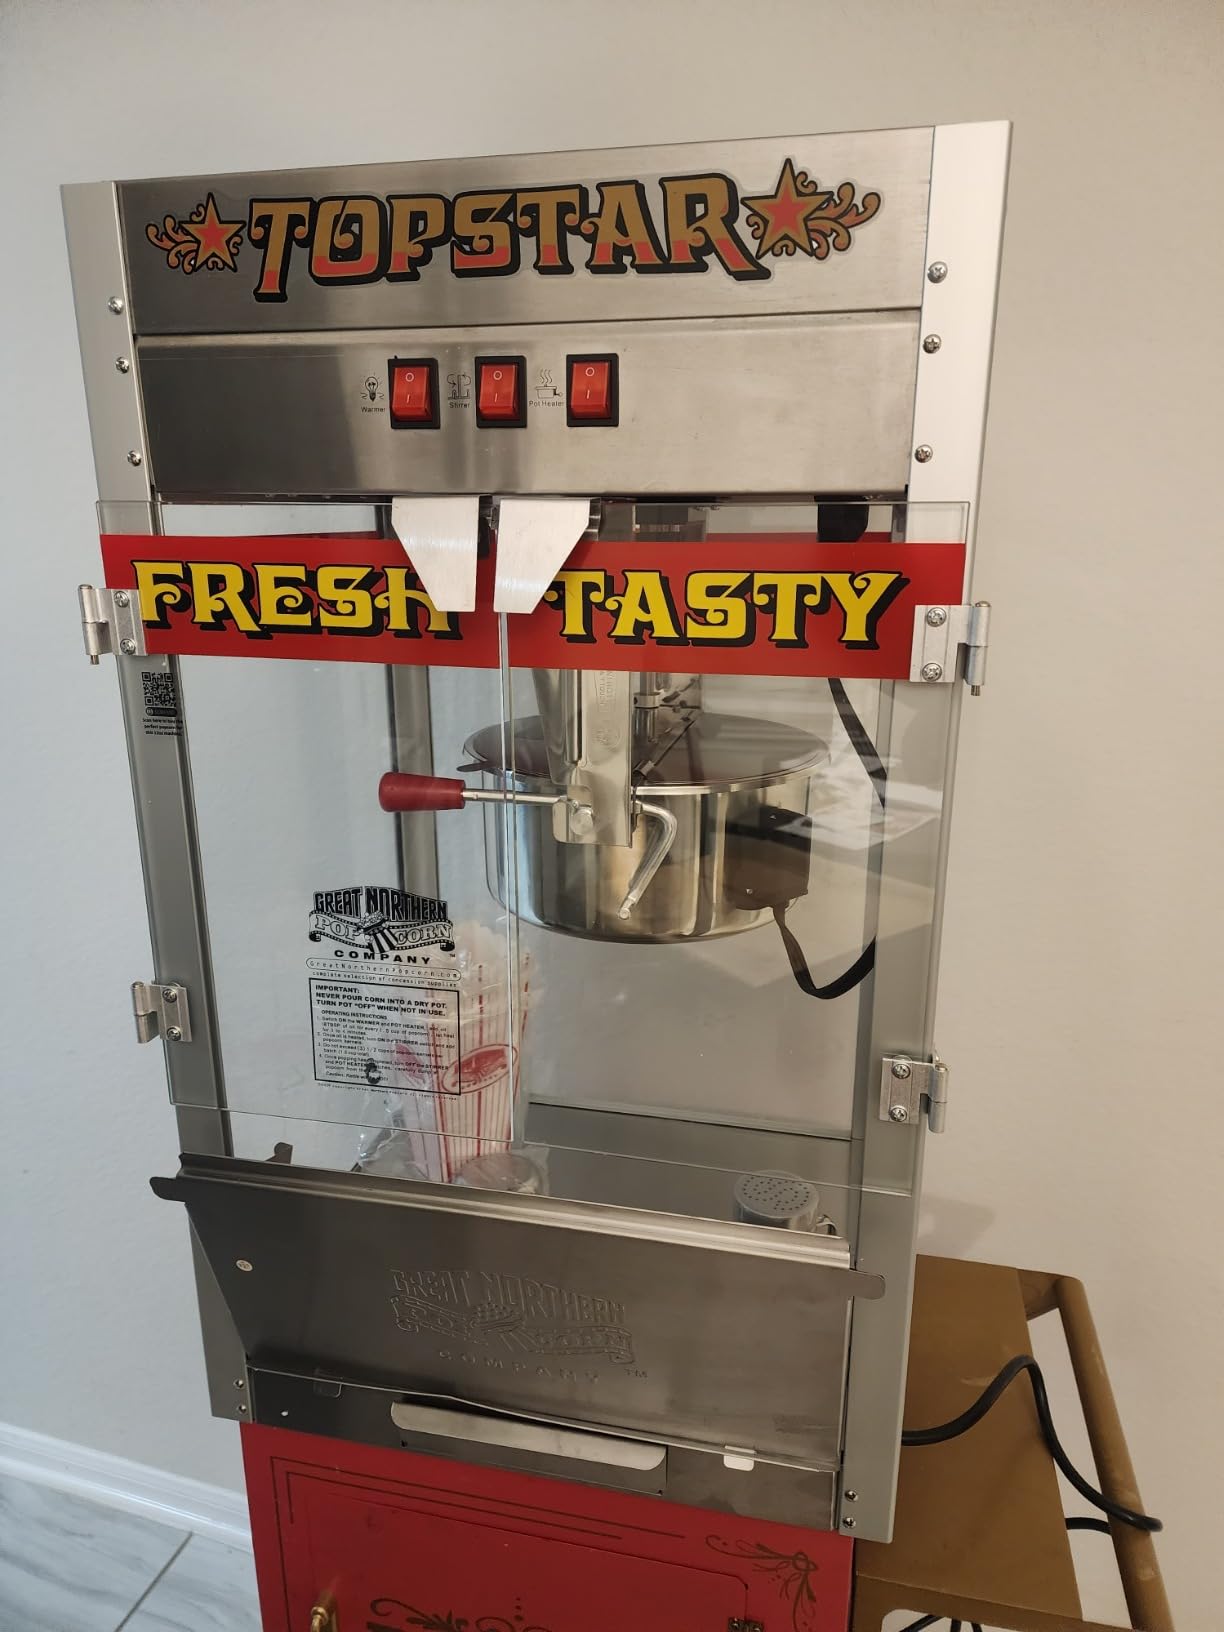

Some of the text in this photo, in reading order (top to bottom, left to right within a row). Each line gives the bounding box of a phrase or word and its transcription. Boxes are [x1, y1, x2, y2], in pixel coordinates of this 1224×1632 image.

[248, 173, 773, 302] TOPSTAR
[131, 560, 910, 650] FRESH TASTY
[313, 886, 448, 921] GREAT NORTHERN
[314, 915, 452, 945] POP CORN
[334, 949, 430, 964] COMPANY
[343, 973, 376, 981] selection
[315, 984, 360, 994] IMPORTANT:
[315, 992, 340, 1000] NEVER
[342, 994, 363, 1002] POUR
[364, 996, 385, 1004] CORN
[387, 997, 405, 1005] INTO
[316, 999, 337, 1007] TURN
[376, 1004, 399, 1012] WHEN
[428, 1009, 446, 1017] USE.
[321, 1009, 388, 1020] OPERATING INSTRUCTIONS
